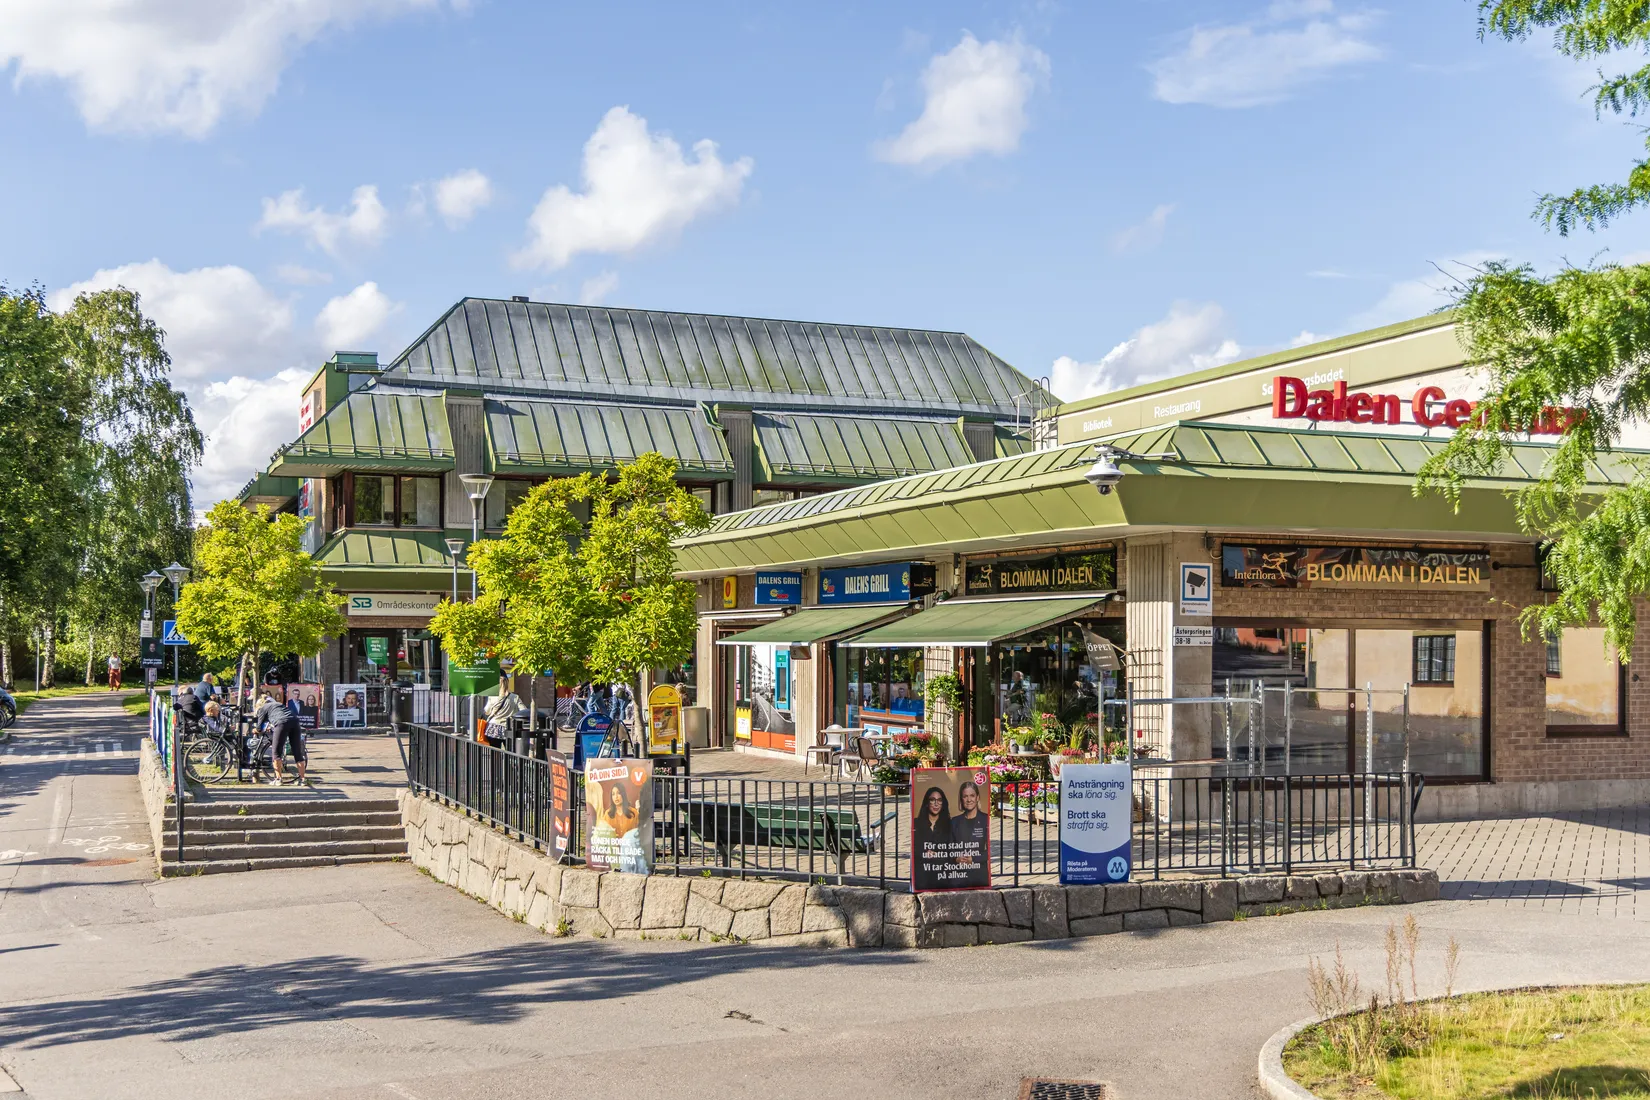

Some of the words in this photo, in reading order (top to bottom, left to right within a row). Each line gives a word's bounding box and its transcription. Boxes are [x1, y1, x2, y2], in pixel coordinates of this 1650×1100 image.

[1262, 368, 1344, 396] Sagsbadet
[1272, 376, 1400, 426] Dalen
[1153, 400, 1201, 419] Restaurang
[1083, 417, 1112, 433] Bibliotek
[1000, 569, 1049, 588] BLOMMAN
[1057, 566, 1093, 585] DALEN
[1234, 568, 1277, 580] Interflora
[1306, 563, 1403, 583] BLOMMAN
[1410, 565, 1415, 583] I
[1420, 566, 1480, 584] DALEN
[758, 576, 782, 584] DALENS
[782, 577, 800, 585] GRILL
[844, 575, 869, 594] DALENS
[870, 574, 890, 593] GRILL
[376, 600, 437, 609] Områdeskontor
[1176, 626, 1211, 636] Åstorpsringen
[1087, 642, 1112, 651] ÖPPET
[589, 768, 598, 781] PÅ
[599, 768, 610, 779] DIN
[611, 766, 627, 777] SIDA
[634, 771, 643, 781] V
[1068, 779, 1125, 790] Ansträngning
[1068, 790, 1083, 798] ska
[1085, 790, 1102, 798] löna
[1104, 790, 1117, 800] sig.
[1067, 810, 1089, 819] Brott
[1091, 810, 1106, 819] ska
[1067, 820, 1094, 831] straffa
[1096, 820, 1109, 831] sig.
[612, 846, 624, 855] TILL
[923, 841, 936, 850] För
[948, 841, 963, 849] stad
[964, 841, 979, 849] utan
[605, 855, 618, 863] OCH
[922, 850, 948, 859] utsatta
[949, 849, 981, 858] områden.
[923, 863, 931, 871] Vi
[932, 863, 943, 871] tar
[944, 862, 981, 871] Stockholm
[937, 871, 947, 880] på
[948, 871, 968, 879] allvar.
